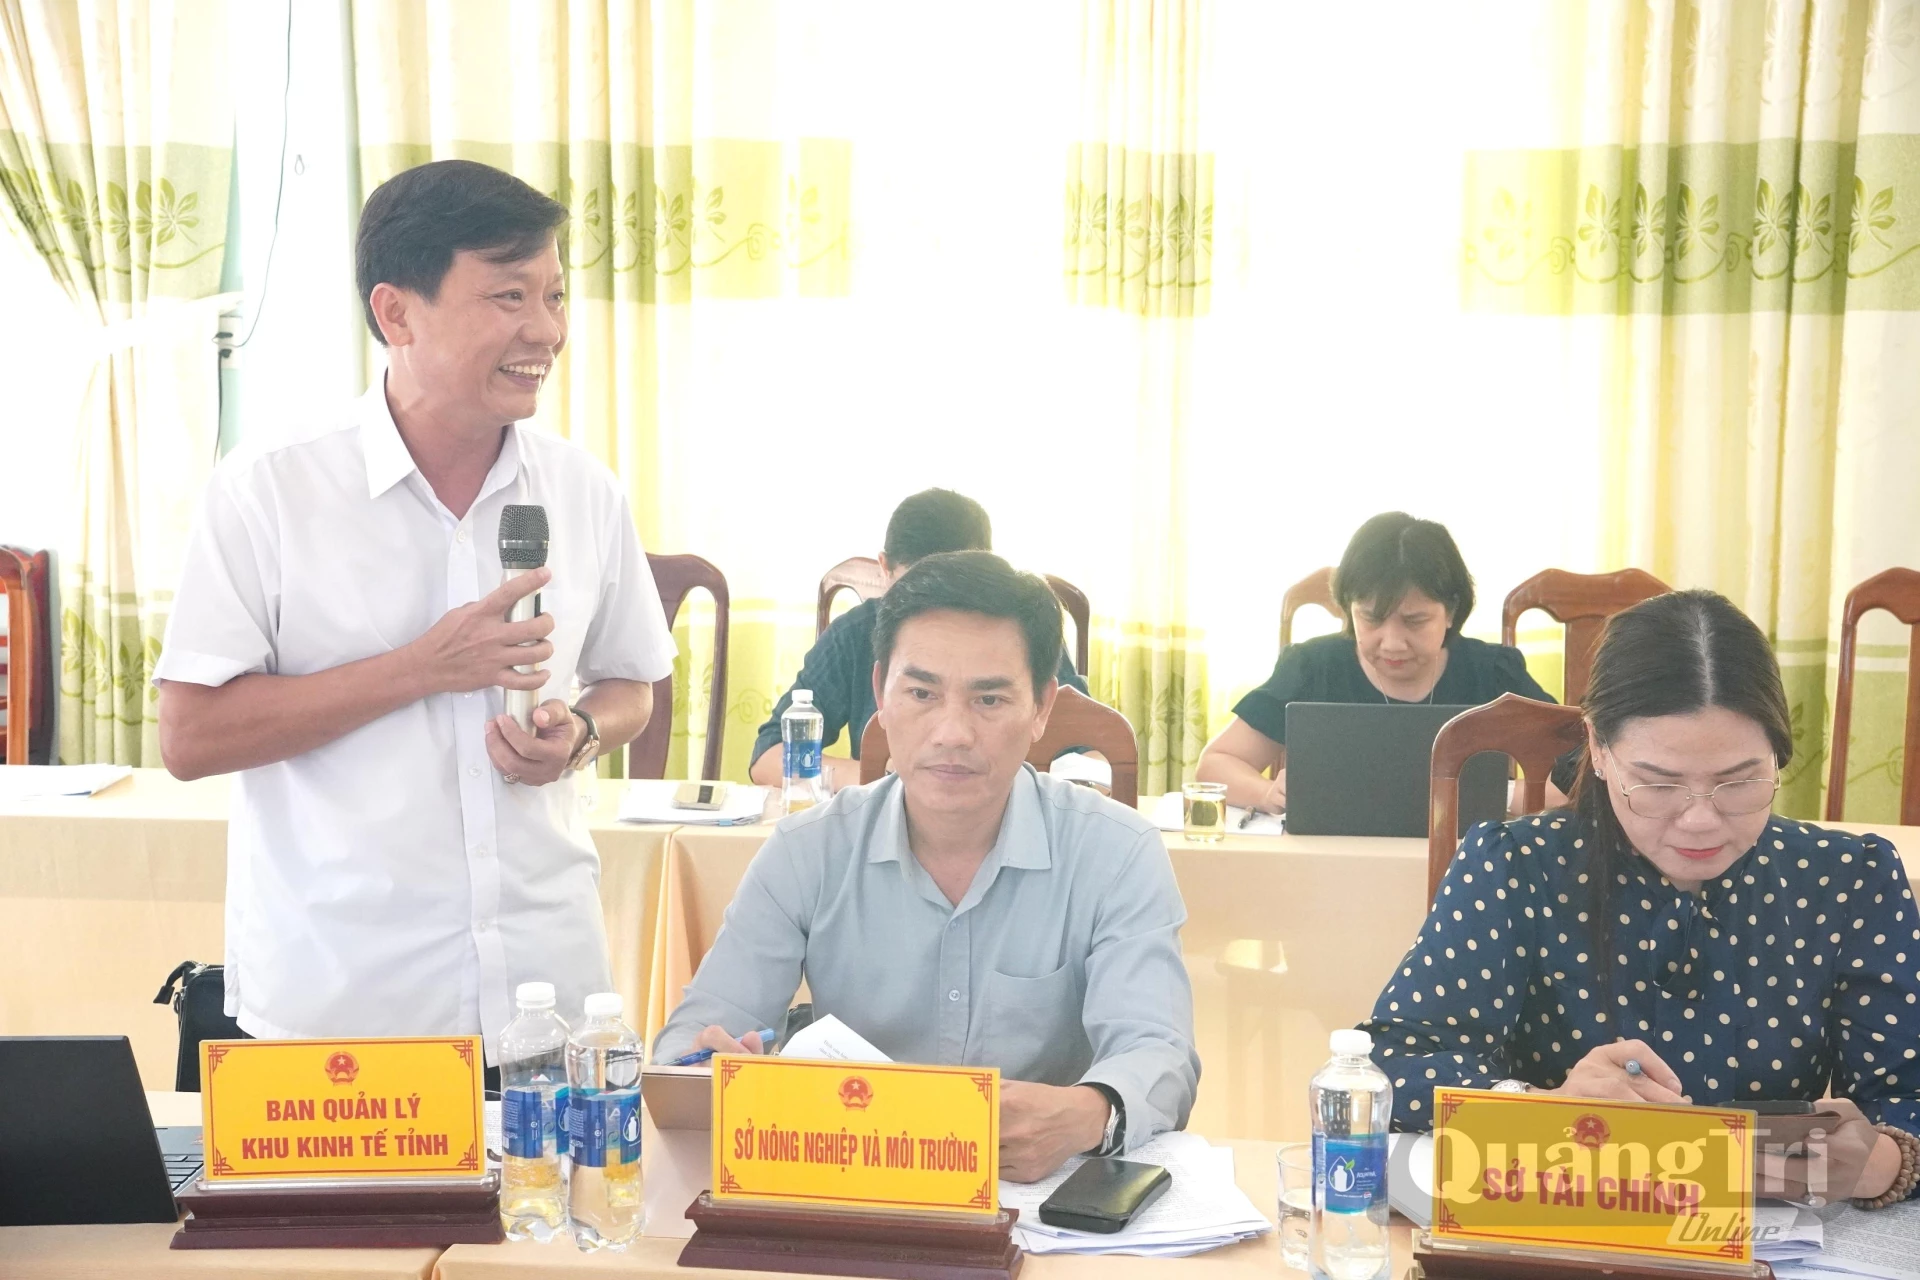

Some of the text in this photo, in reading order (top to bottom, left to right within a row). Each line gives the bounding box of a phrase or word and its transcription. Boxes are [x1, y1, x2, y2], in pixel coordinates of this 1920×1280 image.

[266, 1091, 421, 1123] BAN QUẢN LÝ
[242, 1128, 449, 1160] KHU KINH TẾ TỈNH
[734, 1118, 978, 1173] SỞ NÔNG NGHIỆP VÀ MÔI TRƯỜNG
[1482, 1158, 1699, 1217] SỞ TÀI CHÍNH
